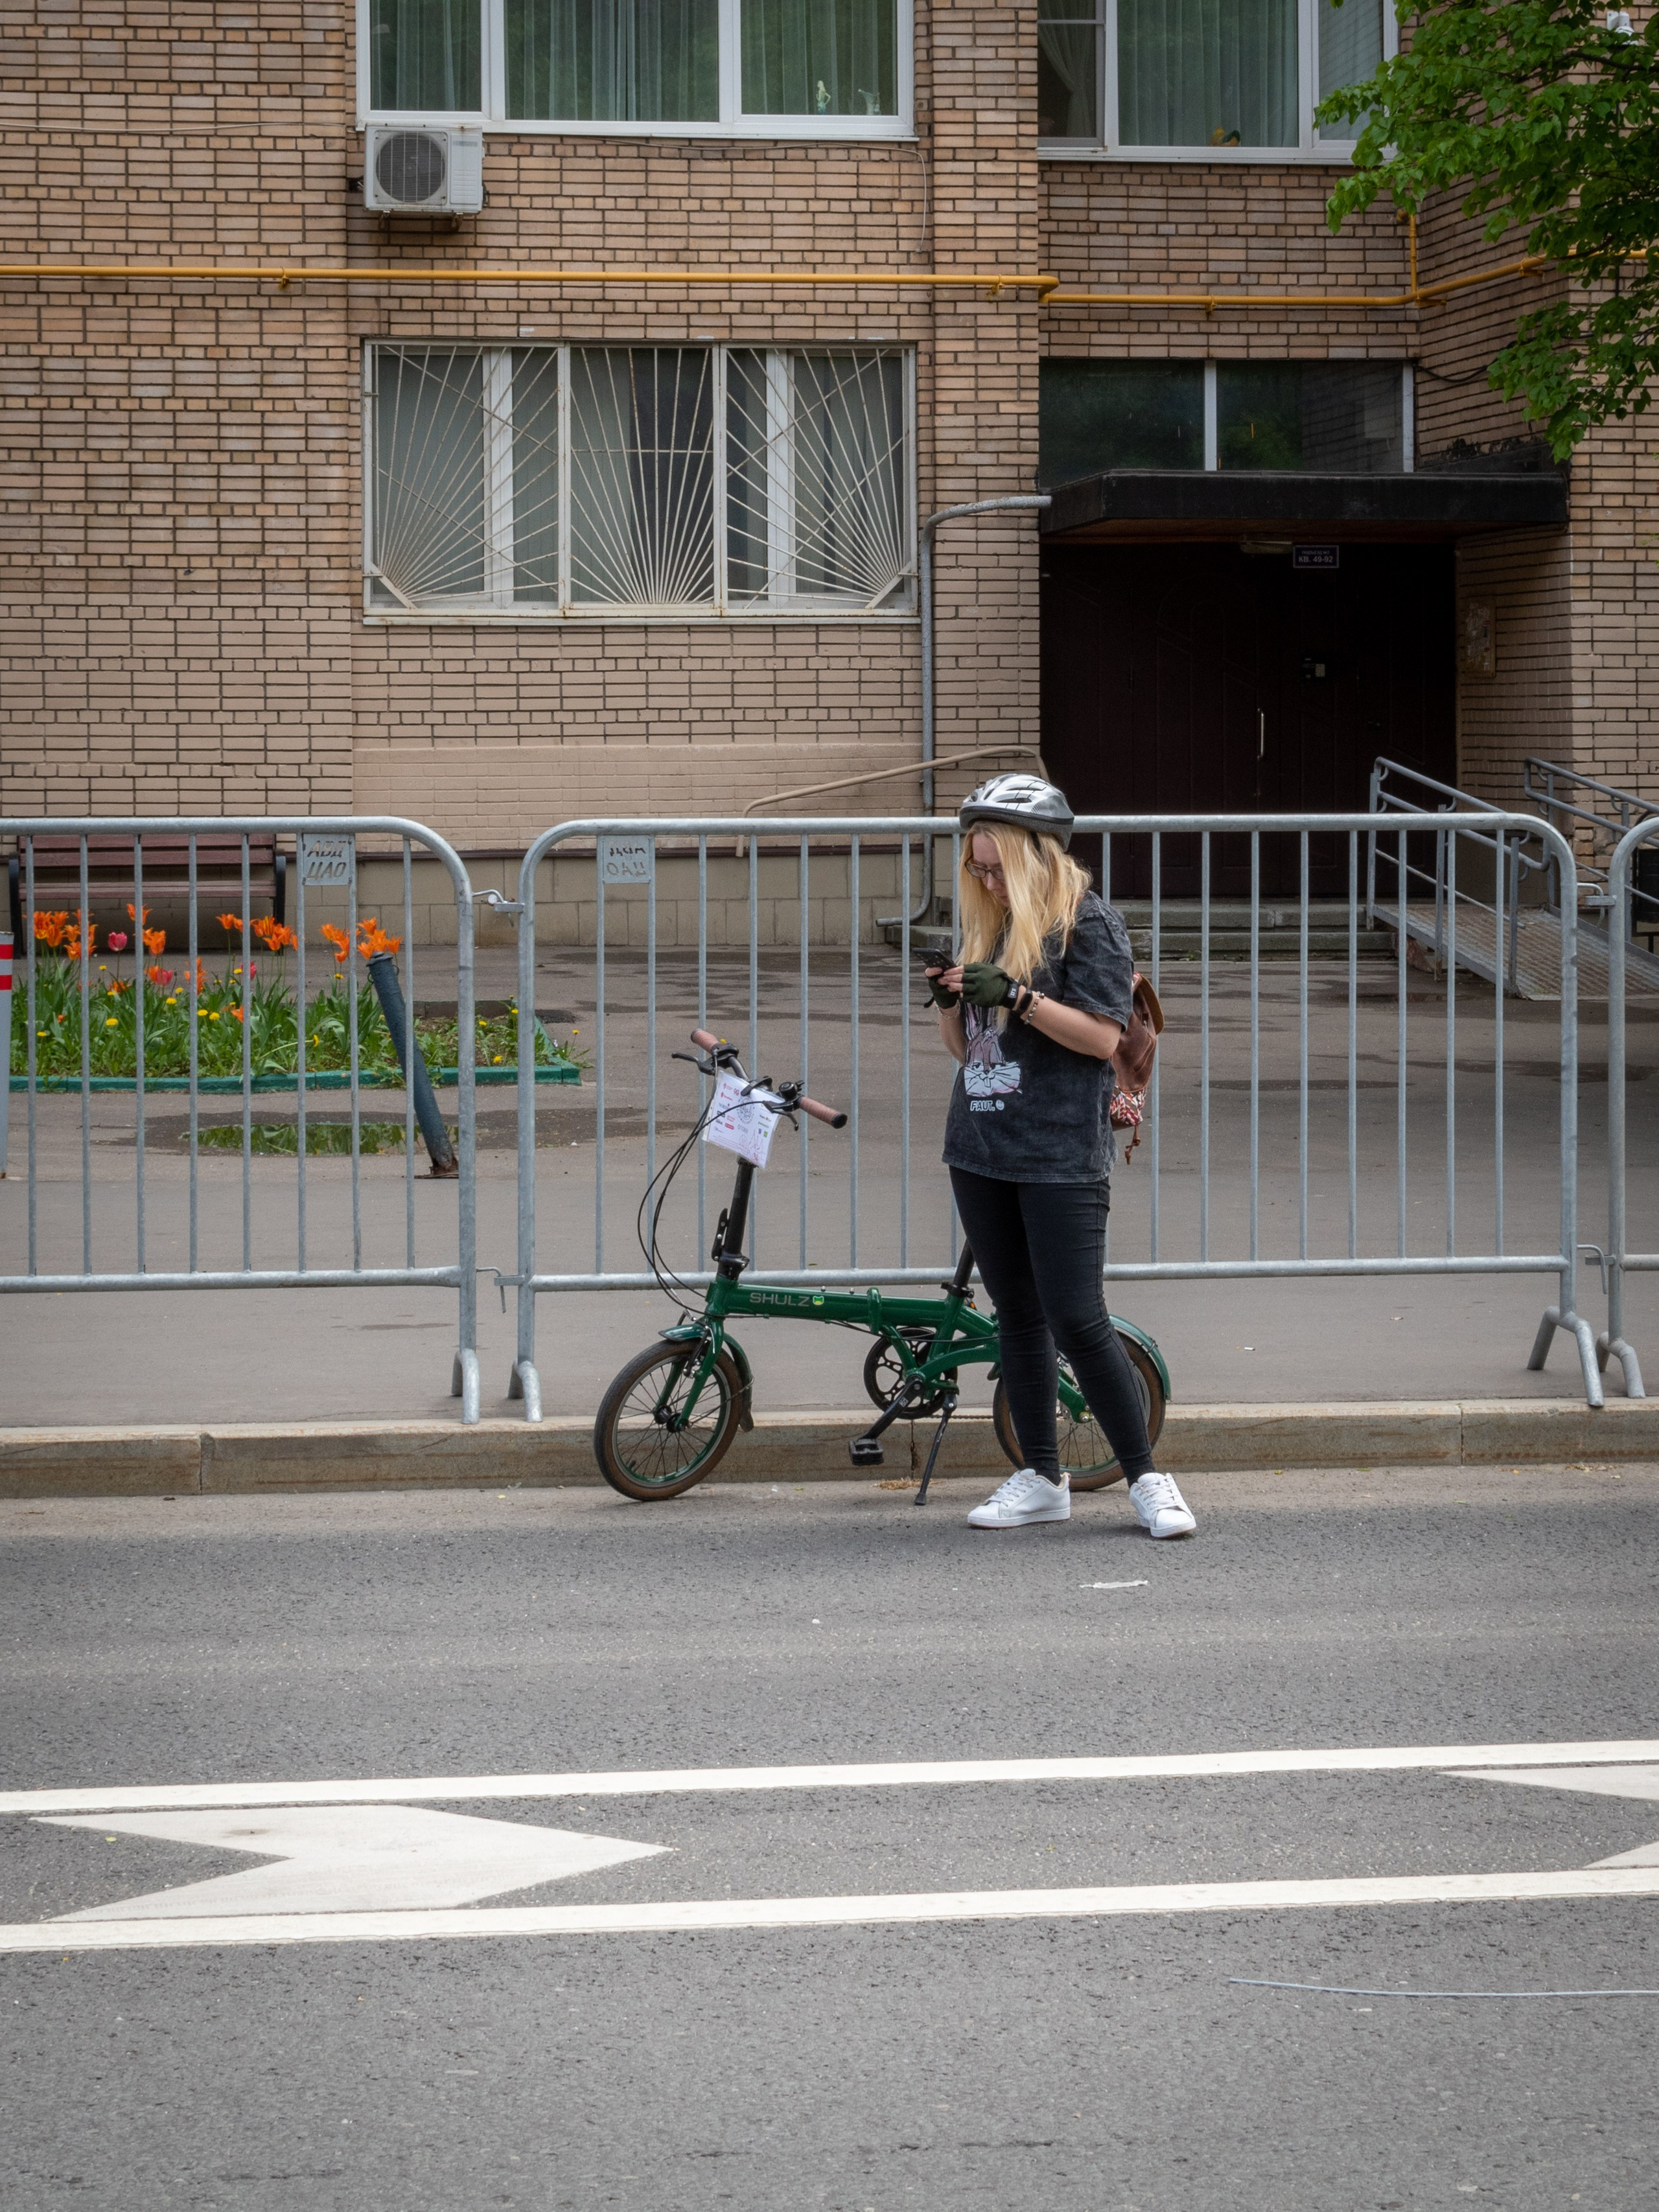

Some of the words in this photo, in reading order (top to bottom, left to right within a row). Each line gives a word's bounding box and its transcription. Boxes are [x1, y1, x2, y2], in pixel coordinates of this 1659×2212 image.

[307, 840, 347, 858] АВД
[306, 861, 347, 880] ЦАО
[749, 1292, 810, 1307] SHULZ
